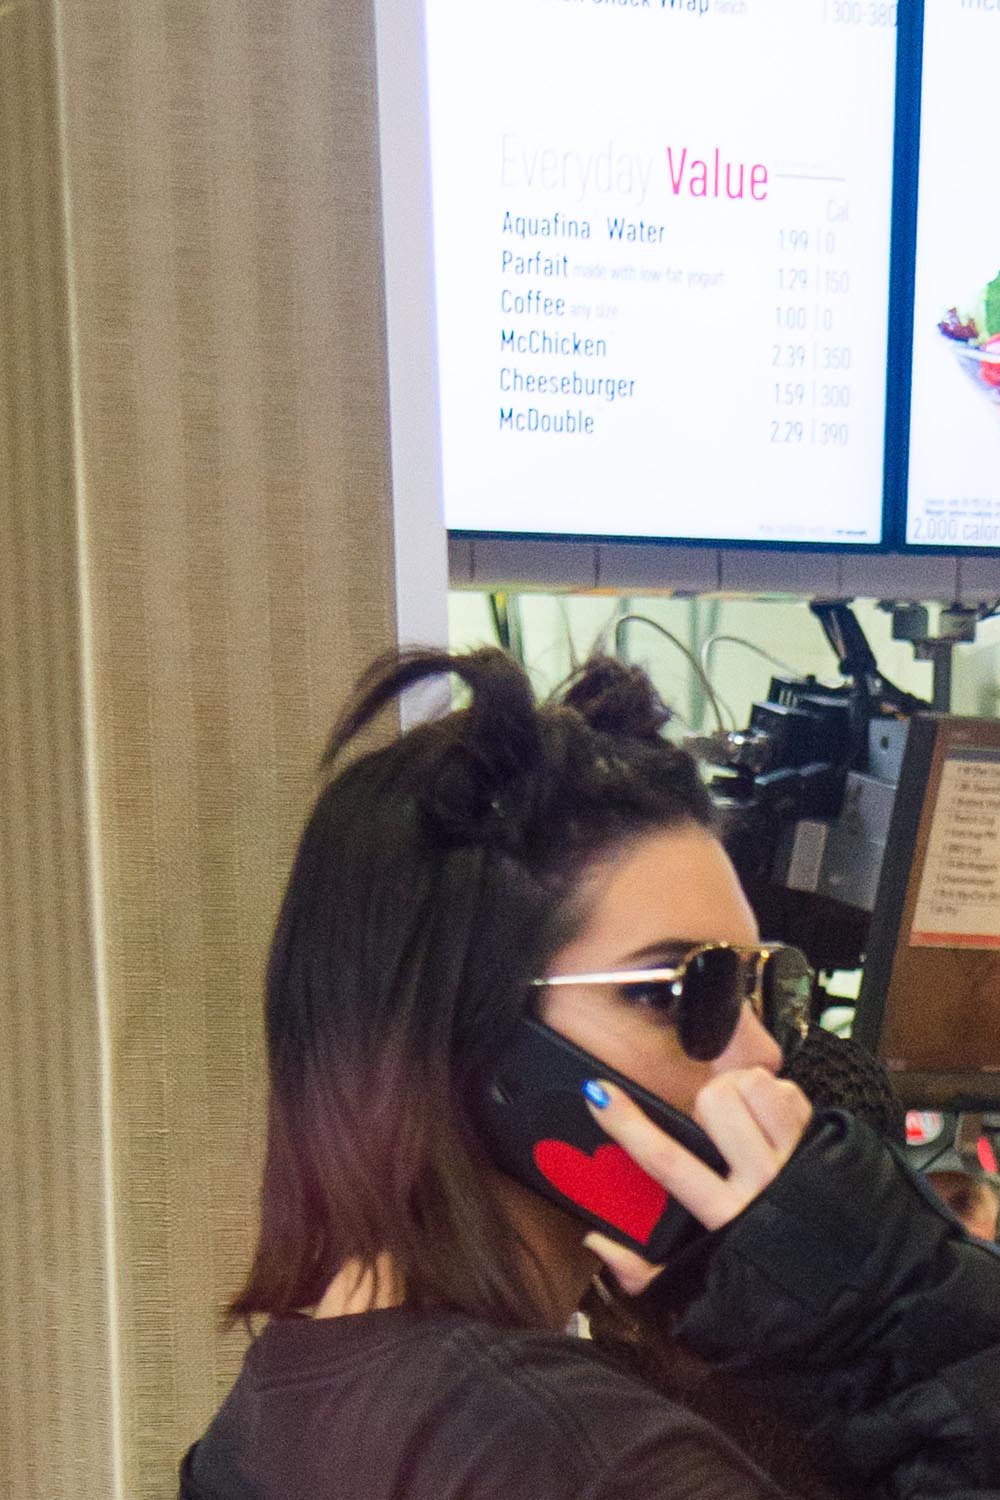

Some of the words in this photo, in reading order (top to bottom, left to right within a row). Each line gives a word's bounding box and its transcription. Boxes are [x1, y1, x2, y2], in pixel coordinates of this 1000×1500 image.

[500, 132, 655, 208] Everyday
[666, 146, 770, 202] Value
[501, 211, 592, 240] Aquafina
[606, 216, 666, 244] Water
[778, 228, 809, 254] 1.99
[824, 230, 836, 254] 0
[501, 250, 570, 280] Parfait
[573, 262, 608, 282] made
[610, 264, 636, 284] with
[686, 268, 725, 290] yogurt
[776, 267, 808, 291] 1.29
[500, 288, 566, 317] Coffee
[570, 301, 592, 321] any
[595, 302, 619, 320] size
[775, 306, 807, 330] 1.00
[822, 308, 833, 331] 0
[500, 330, 607, 358] McChicken
[771, 343, 806, 369] 2.39
[822, 347, 851, 372] 350
[500, 367, 636, 402] Cheeseburger
[773, 382, 805, 406] 1.59
[821, 385, 851, 409] 300
[499, 406, 596, 435] McDouble
[770, 420, 804, 445] 2.29
[819, 423, 849, 448] 390
